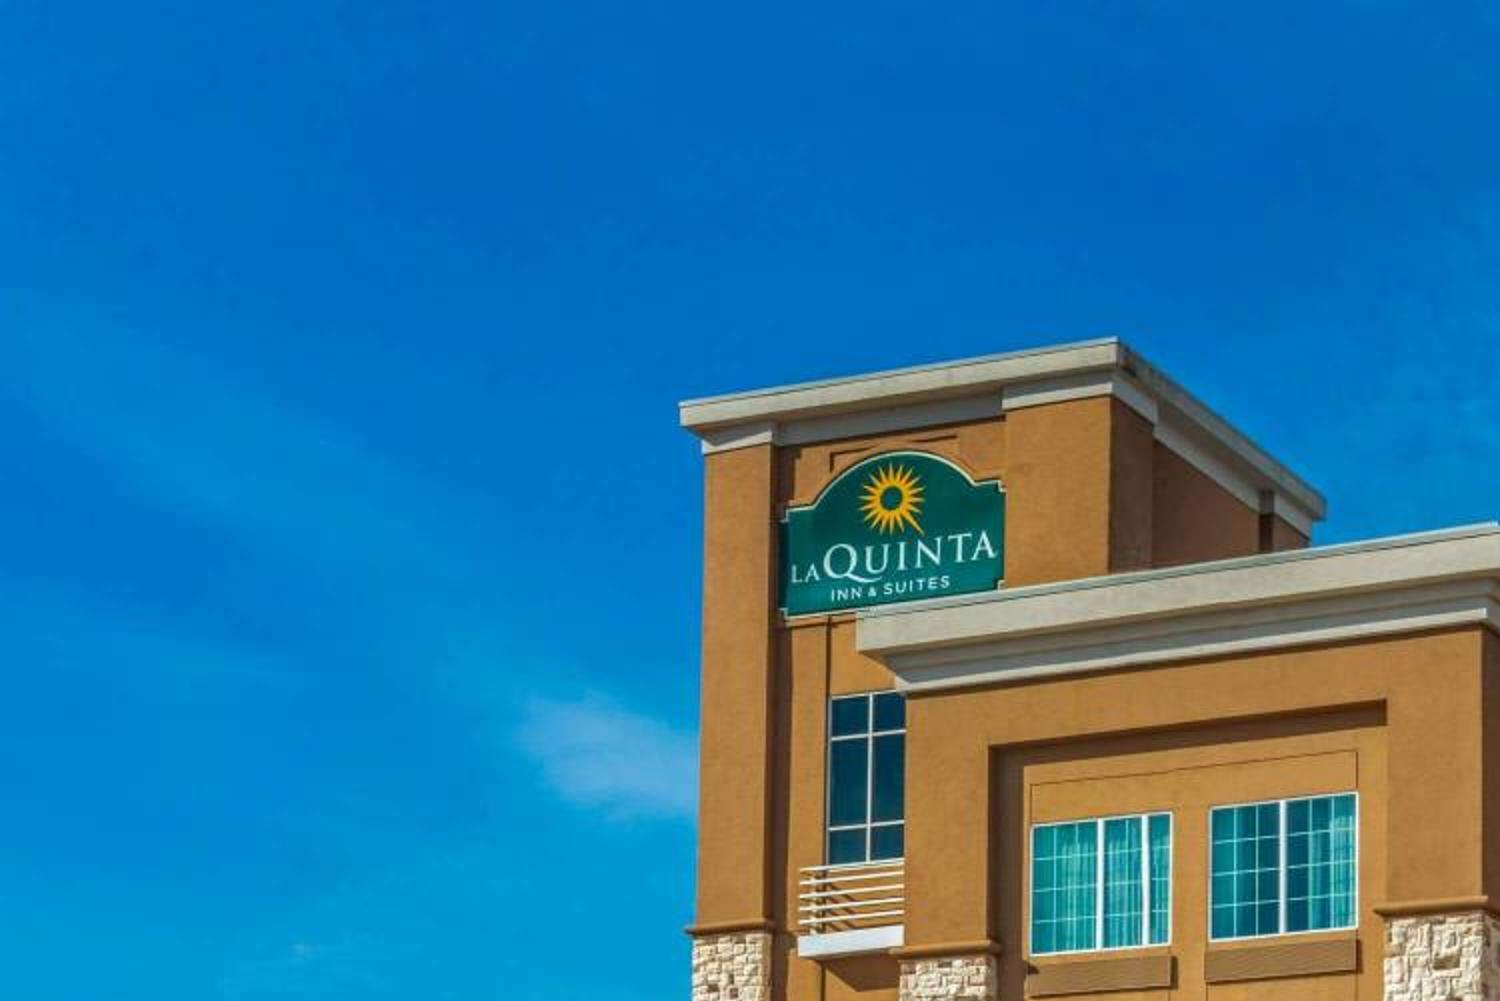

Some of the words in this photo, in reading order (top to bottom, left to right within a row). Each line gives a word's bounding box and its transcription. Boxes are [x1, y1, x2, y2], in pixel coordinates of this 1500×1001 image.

[791, 563, 820, 583] LA
[823, 530, 998, 583] QUINTA
[831, 587, 862, 602] INN
[883, 575, 950, 595] SUITES
